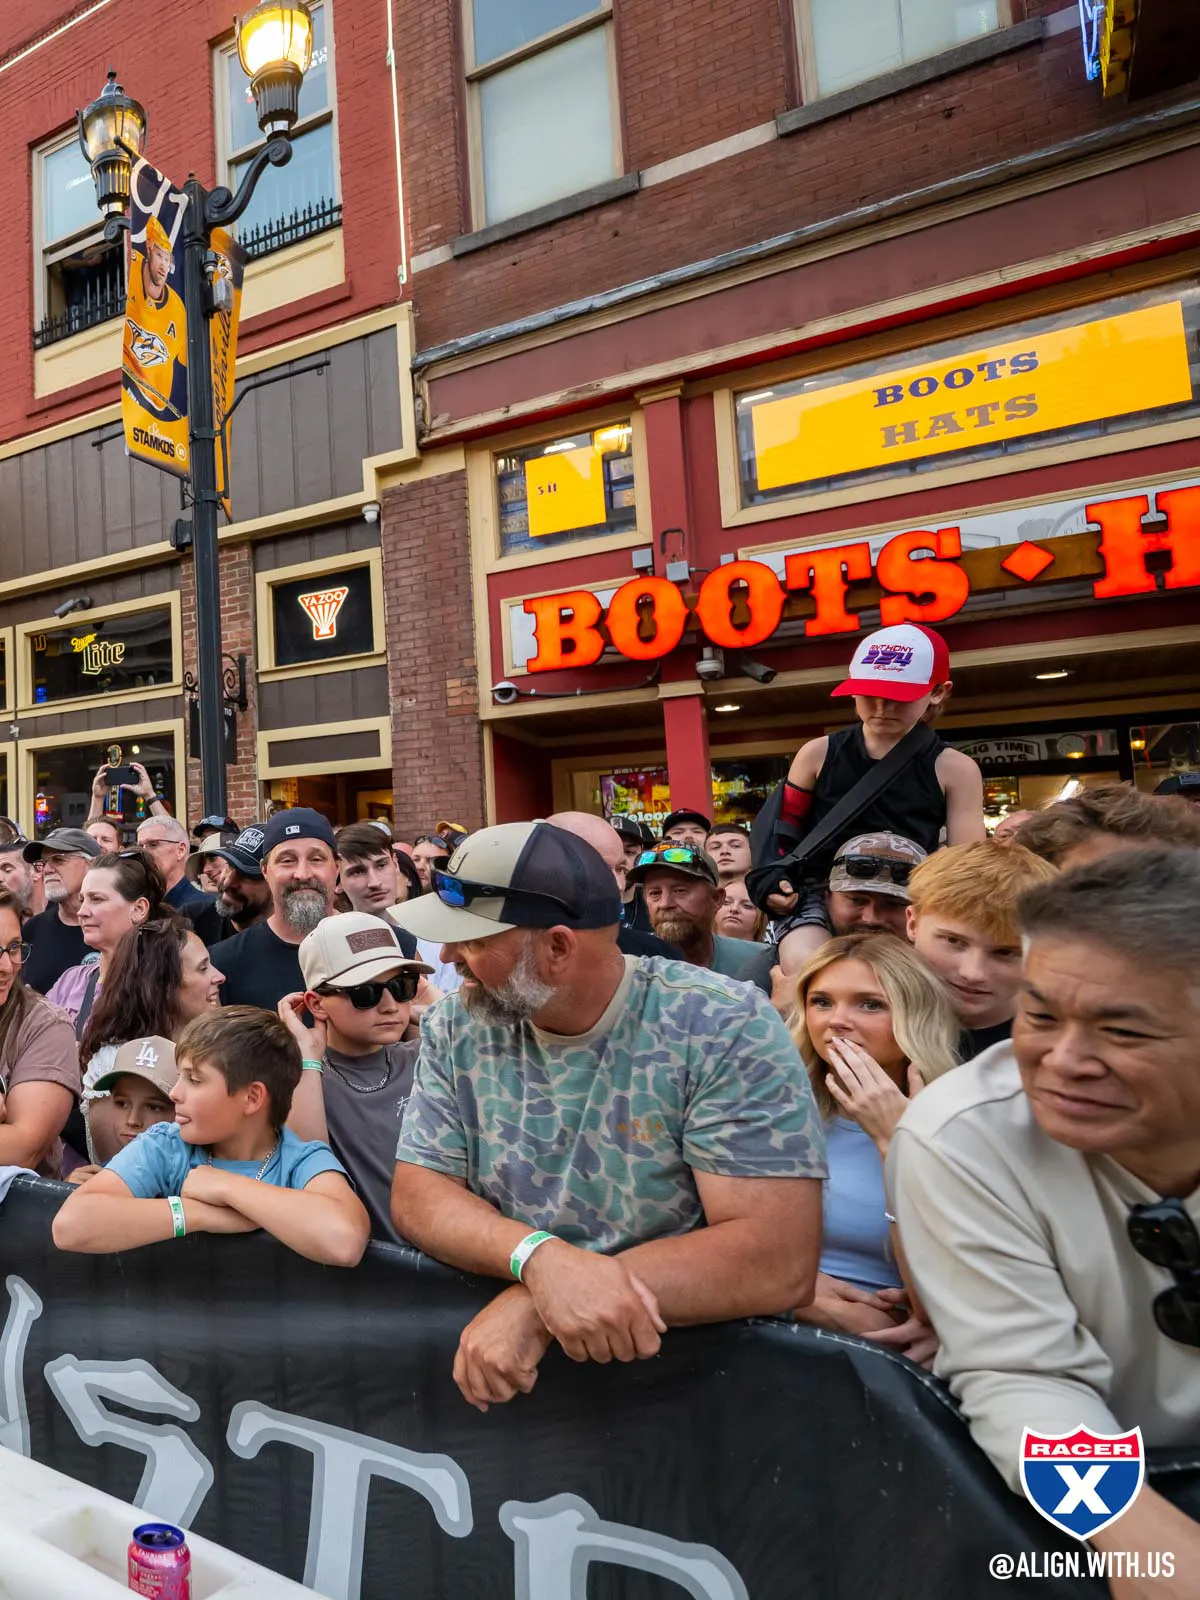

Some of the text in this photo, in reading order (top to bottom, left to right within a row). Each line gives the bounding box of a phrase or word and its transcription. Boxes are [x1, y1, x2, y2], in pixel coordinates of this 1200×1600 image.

[873, 350, 1040, 408] BOOTS
[880, 393, 1039, 449] HATS
[133, 427, 175, 458] STAMKOS
[303, 591, 343, 607] YAZOO
[522, 525, 970, 674] BOOTS
[82, 641, 125, 675] Lite
[861, 649, 914, 667] 224
[870, 644, 914, 652] ANTHONY
[994, 741, 1035, 755] TIME
[136, 1041, 159, 1068] LA
